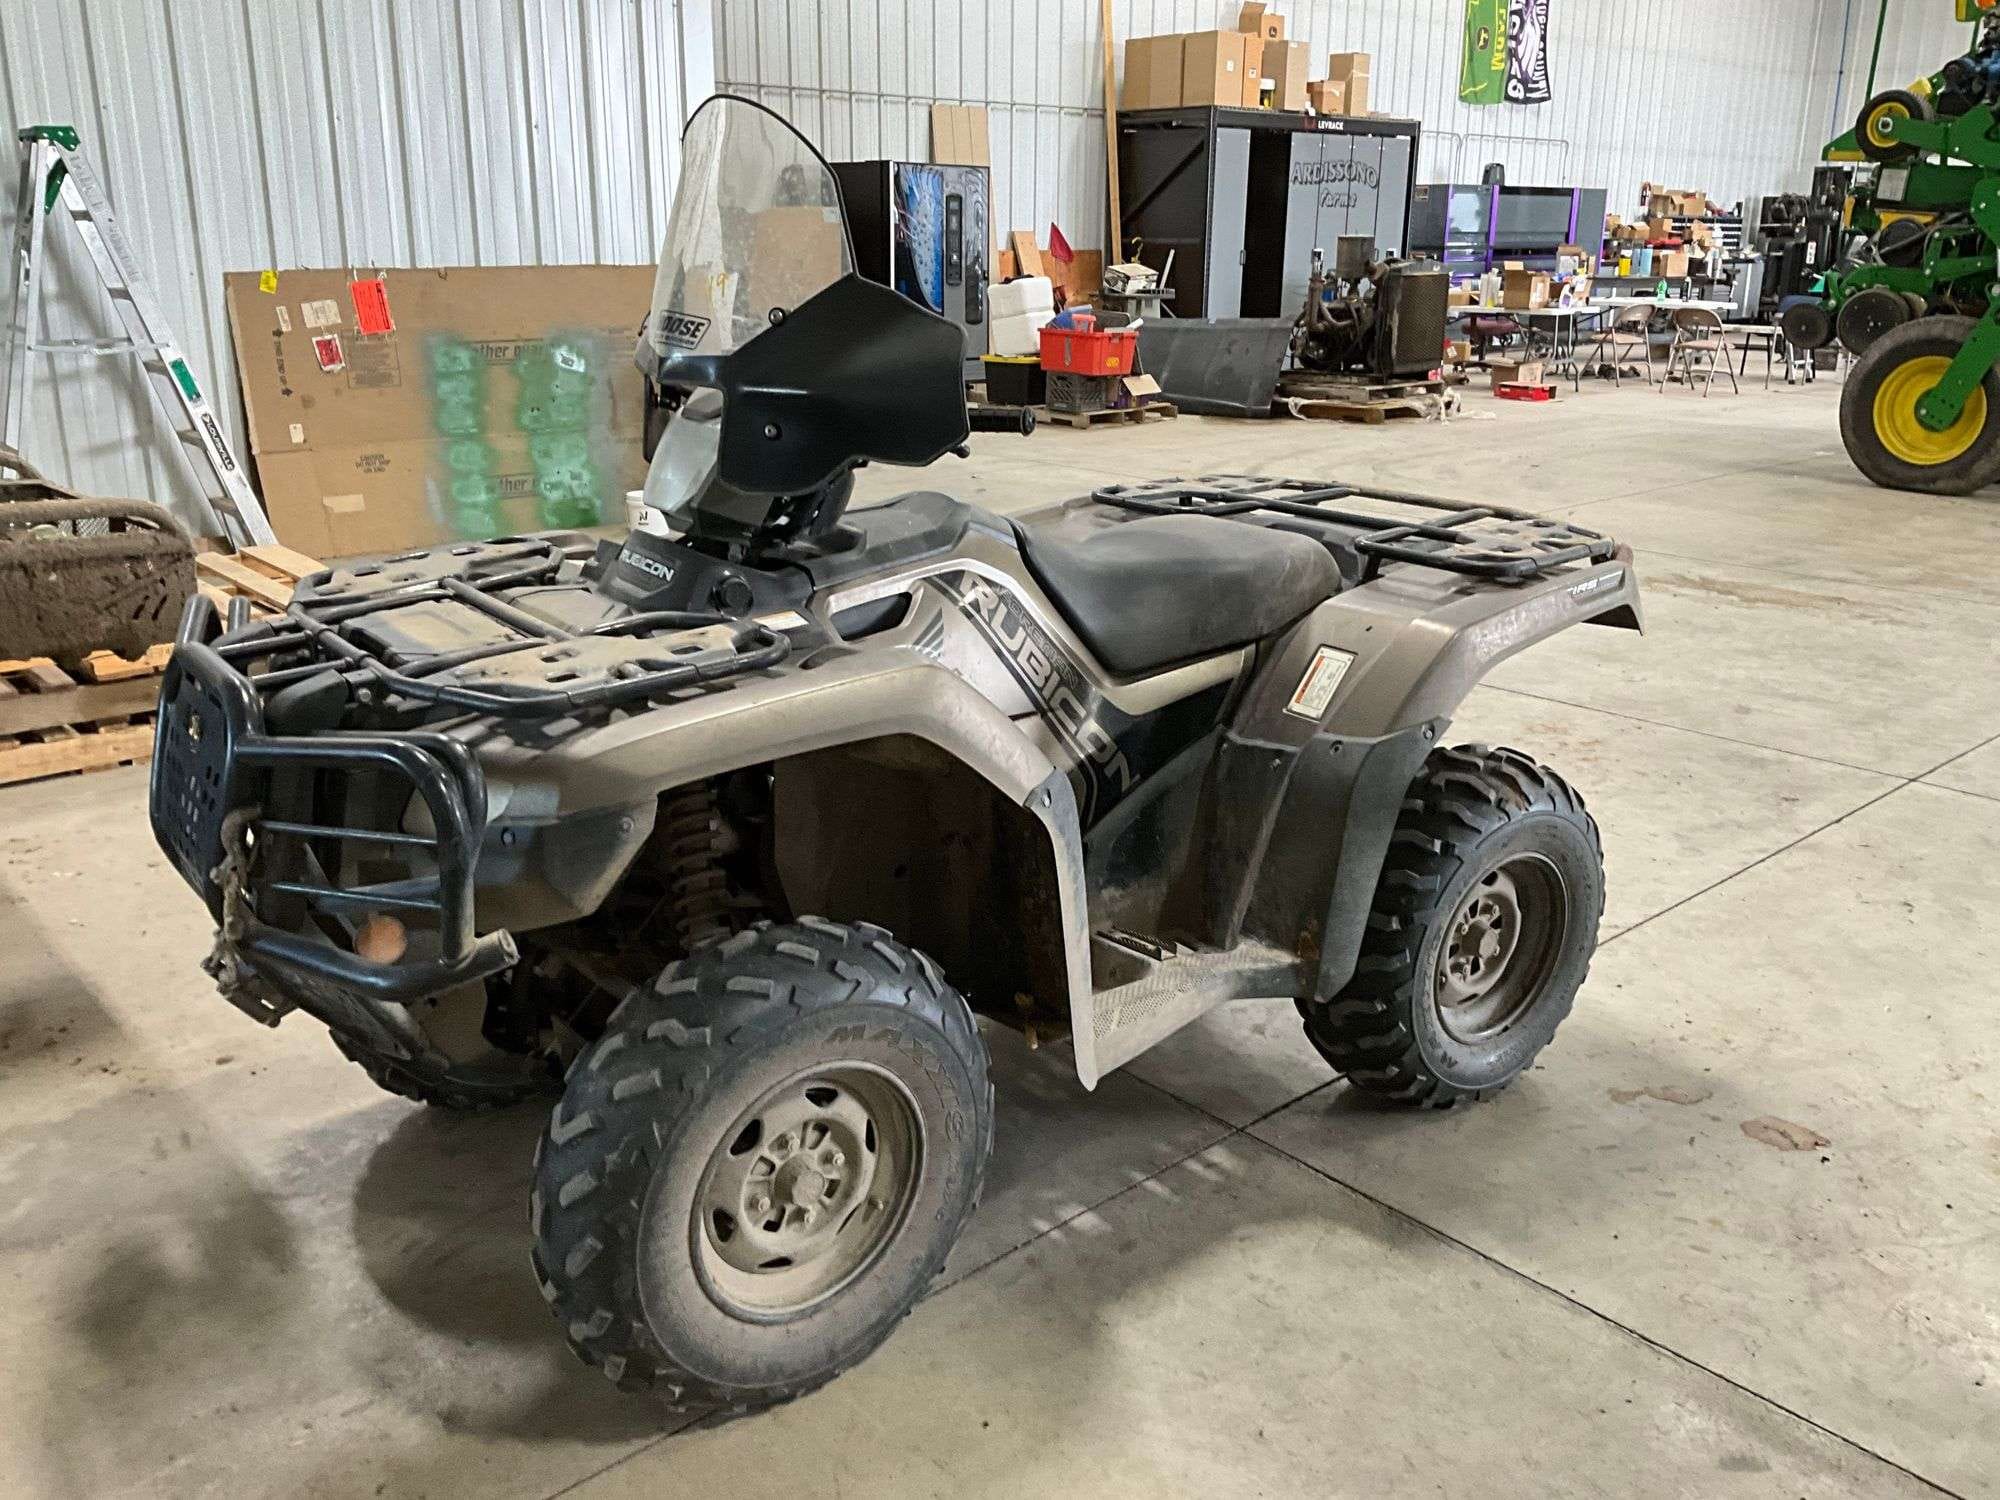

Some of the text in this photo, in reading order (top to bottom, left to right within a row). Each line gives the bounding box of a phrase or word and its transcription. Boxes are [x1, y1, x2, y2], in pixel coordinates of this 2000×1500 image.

[1291, 160, 1378, 189] ARDISSONO
[207, 421, 235, 472] LOUISVILLE
[959, 570, 1141, 794] RUBICON
